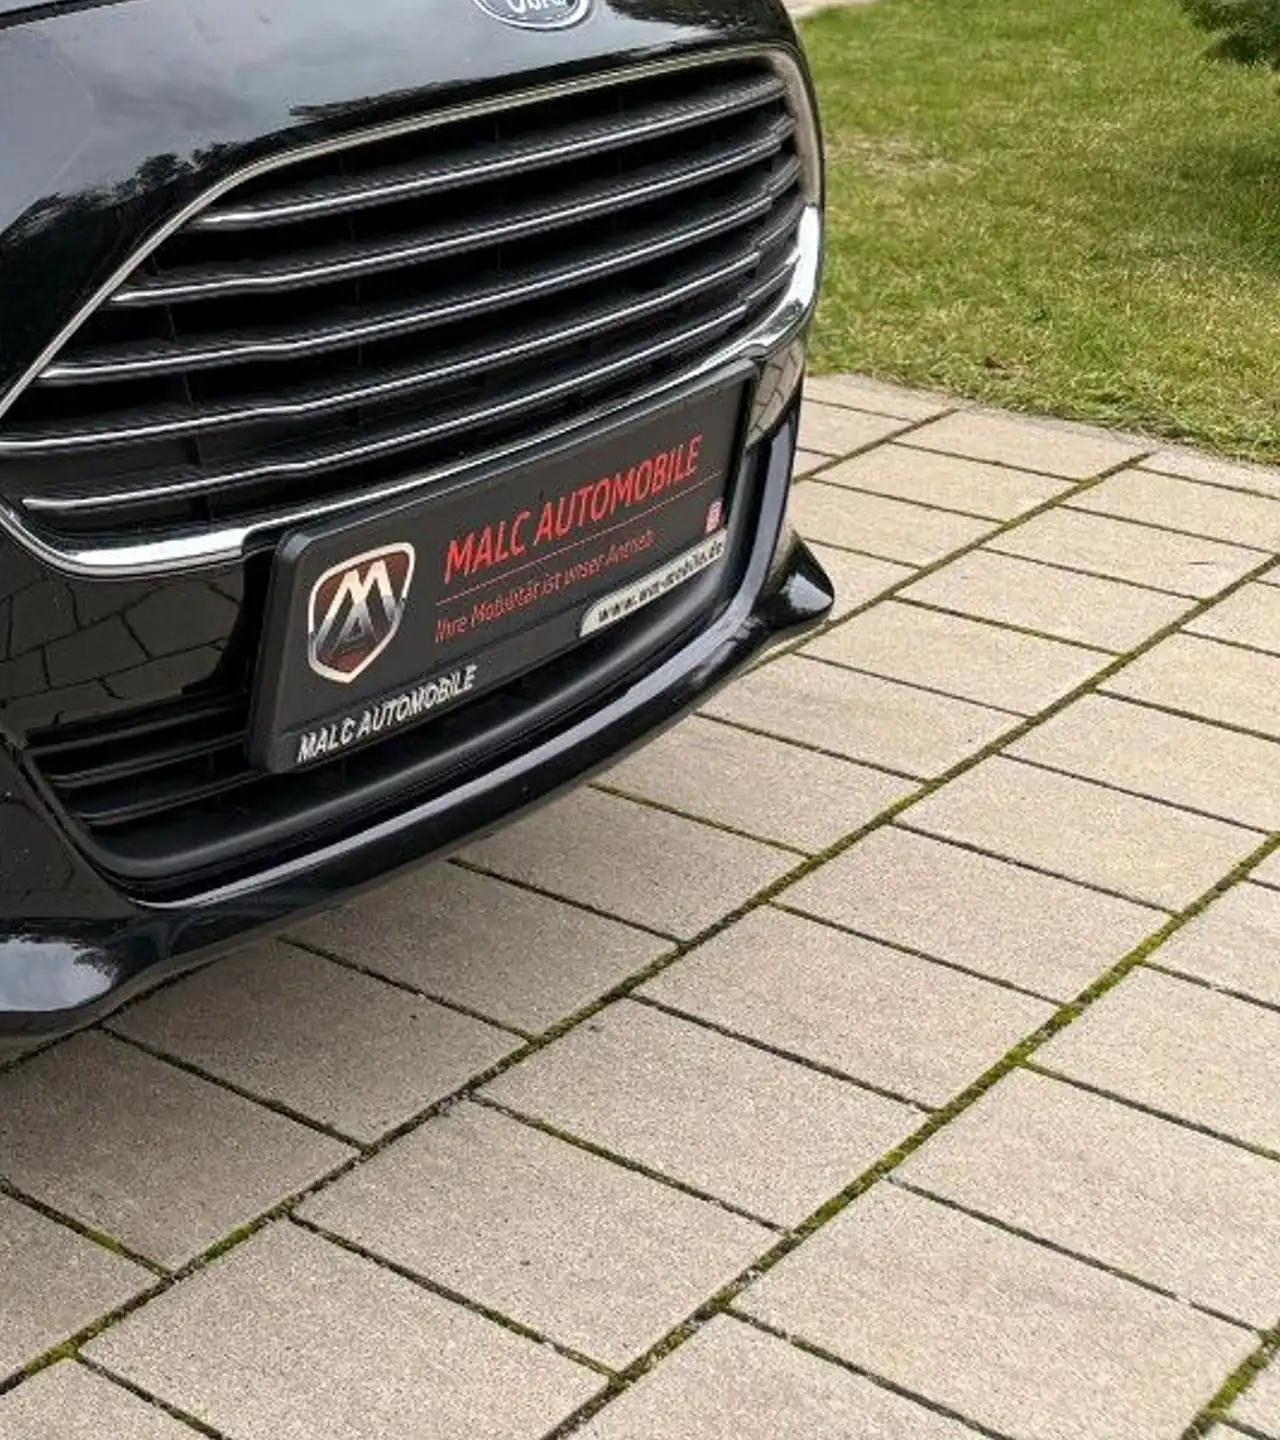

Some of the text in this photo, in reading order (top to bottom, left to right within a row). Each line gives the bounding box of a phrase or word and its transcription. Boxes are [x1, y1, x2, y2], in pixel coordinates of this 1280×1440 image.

[444, 434, 703, 584] MALC AUTOMOBILE
[297, 662, 478, 764] MALC AUTOMOBILE
